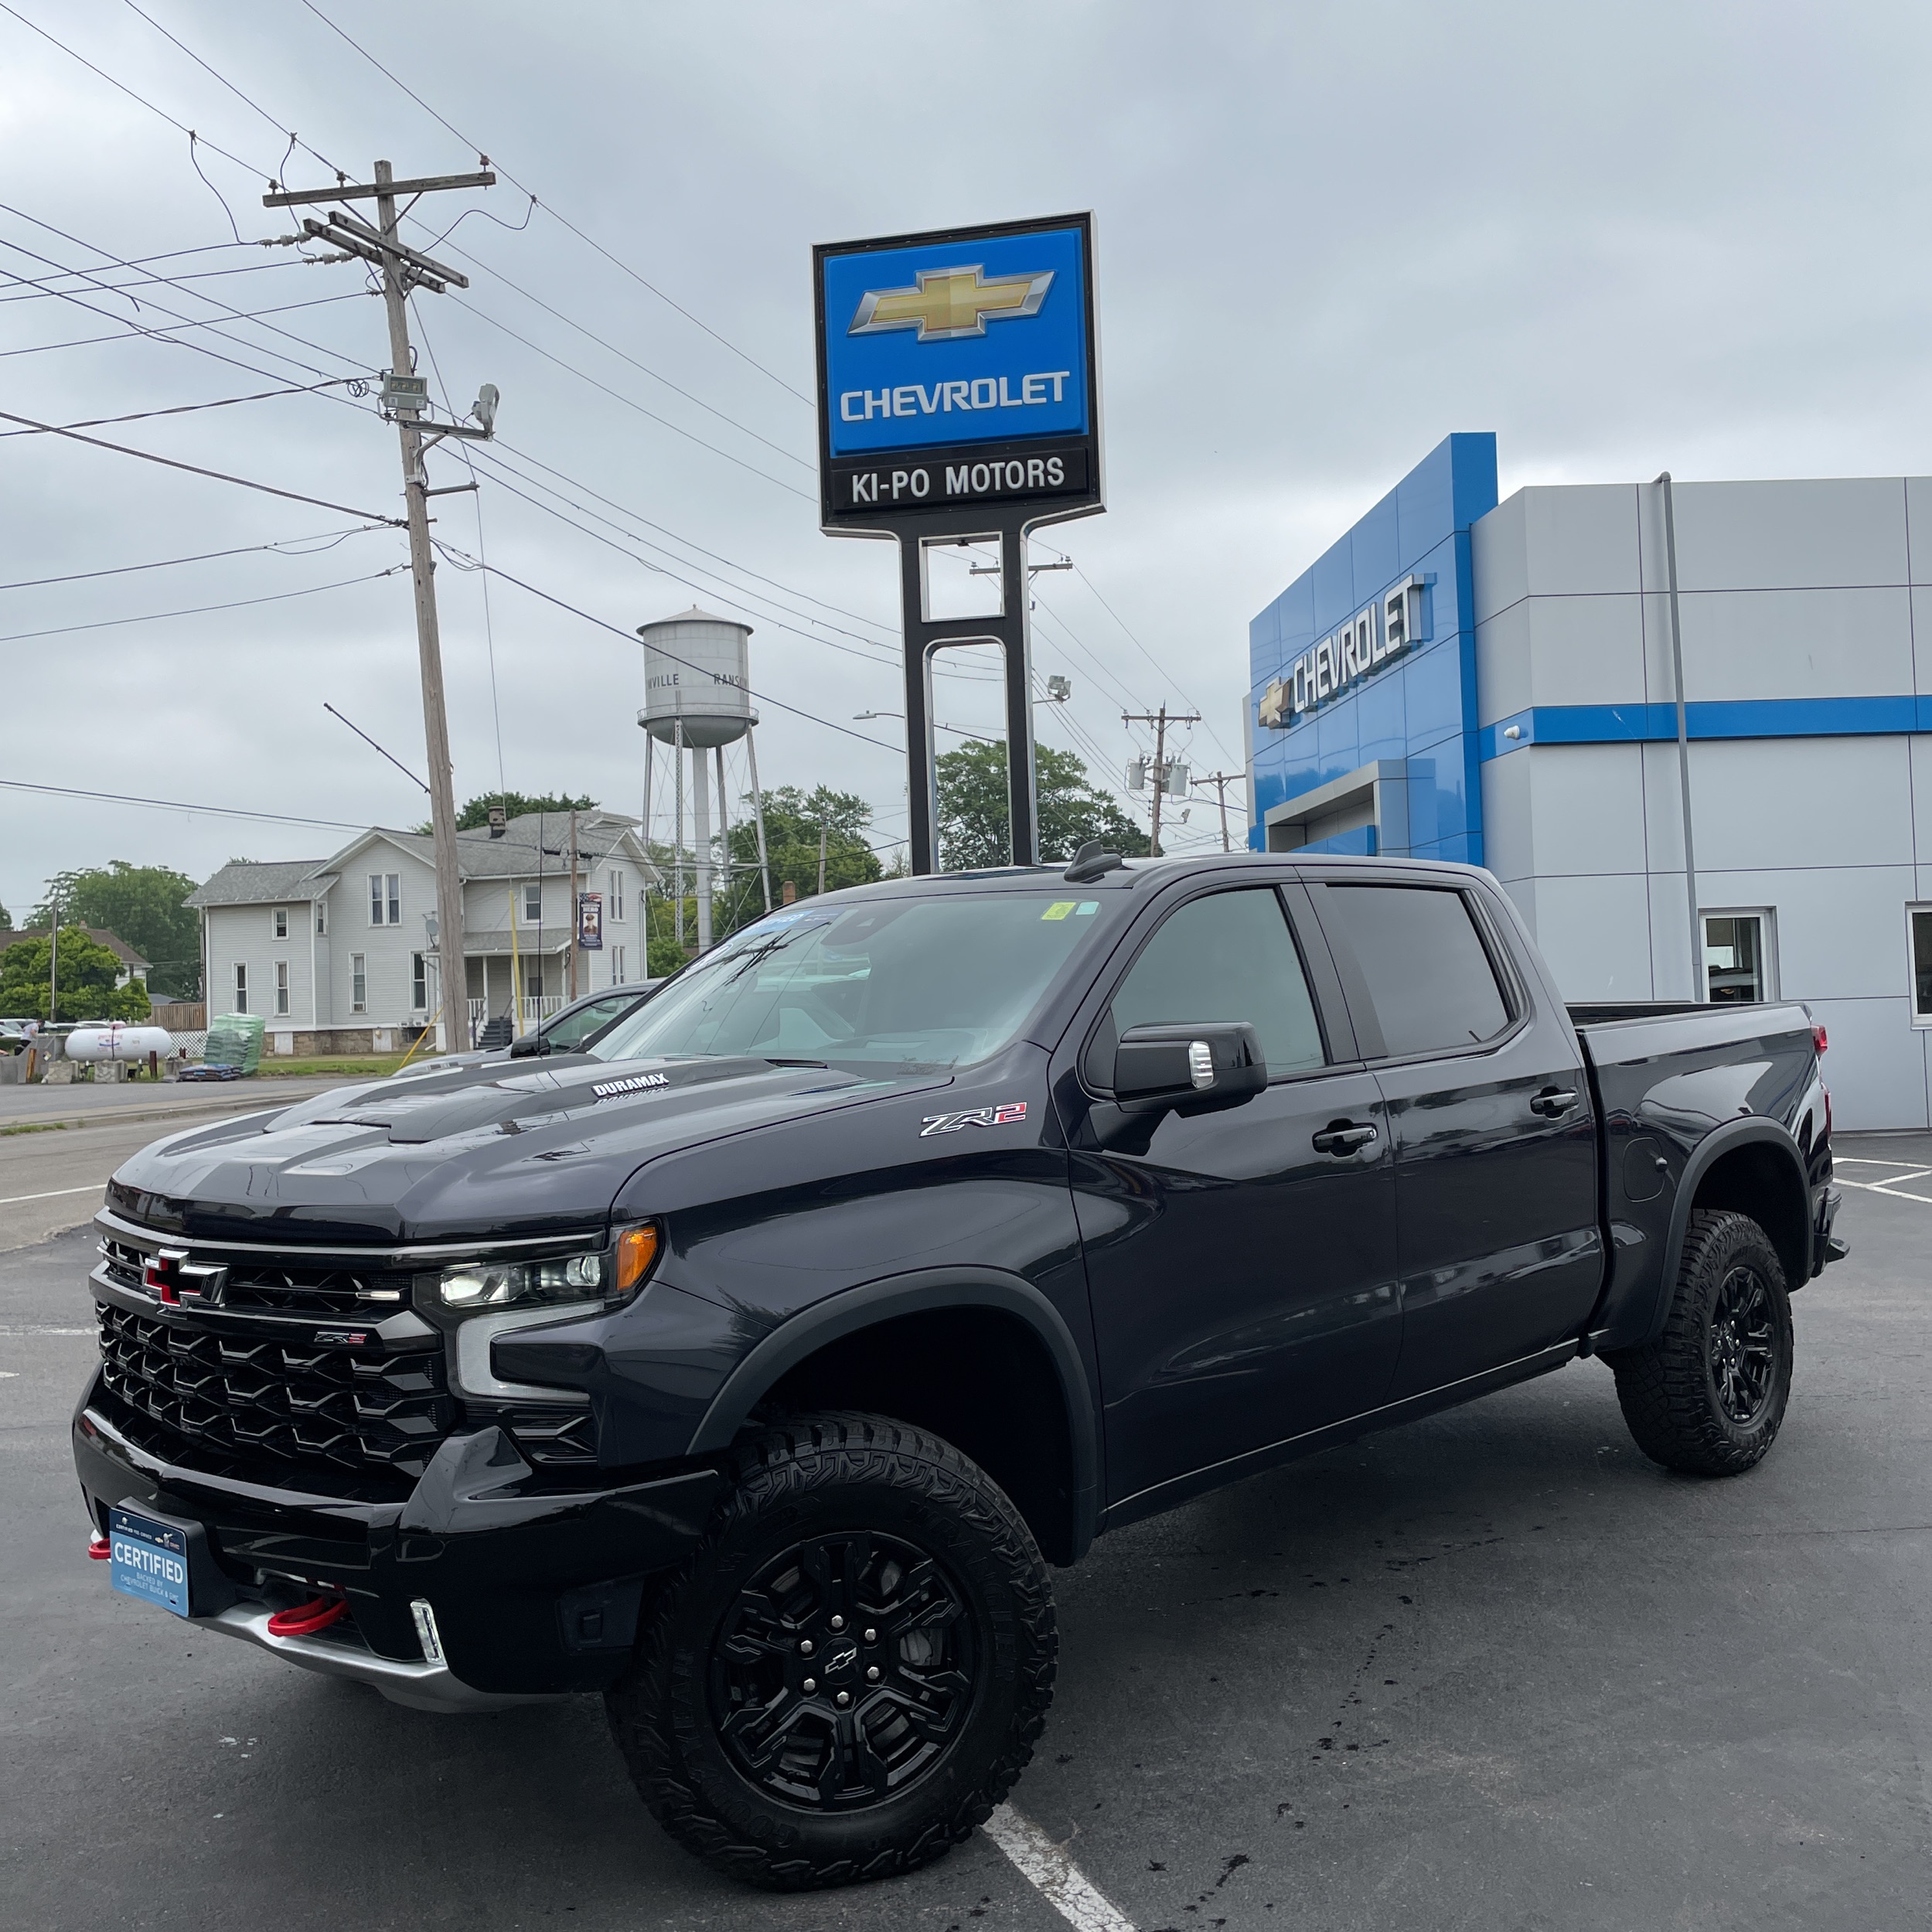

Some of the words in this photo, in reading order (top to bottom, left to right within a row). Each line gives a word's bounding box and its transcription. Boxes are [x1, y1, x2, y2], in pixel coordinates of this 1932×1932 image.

[840, 371, 1070, 422] CHEVROLET
[851, 468, 930, 503] KI-PO
[946, 456, 1065, 496] MOTORS
[1293, 573, 1416, 714] CHEVROLET
[592, 1072, 670, 1097] DURAMAX
[919, 1102, 1027, 1137] ZR2
[313, 1331, 367, 1344] ZR2
[114, 1542, 183, 1584] CERTIFIED
[136, 1573, 155, 1585] BACKED
[121, 1574, 148, 1592] CHEVROLET
